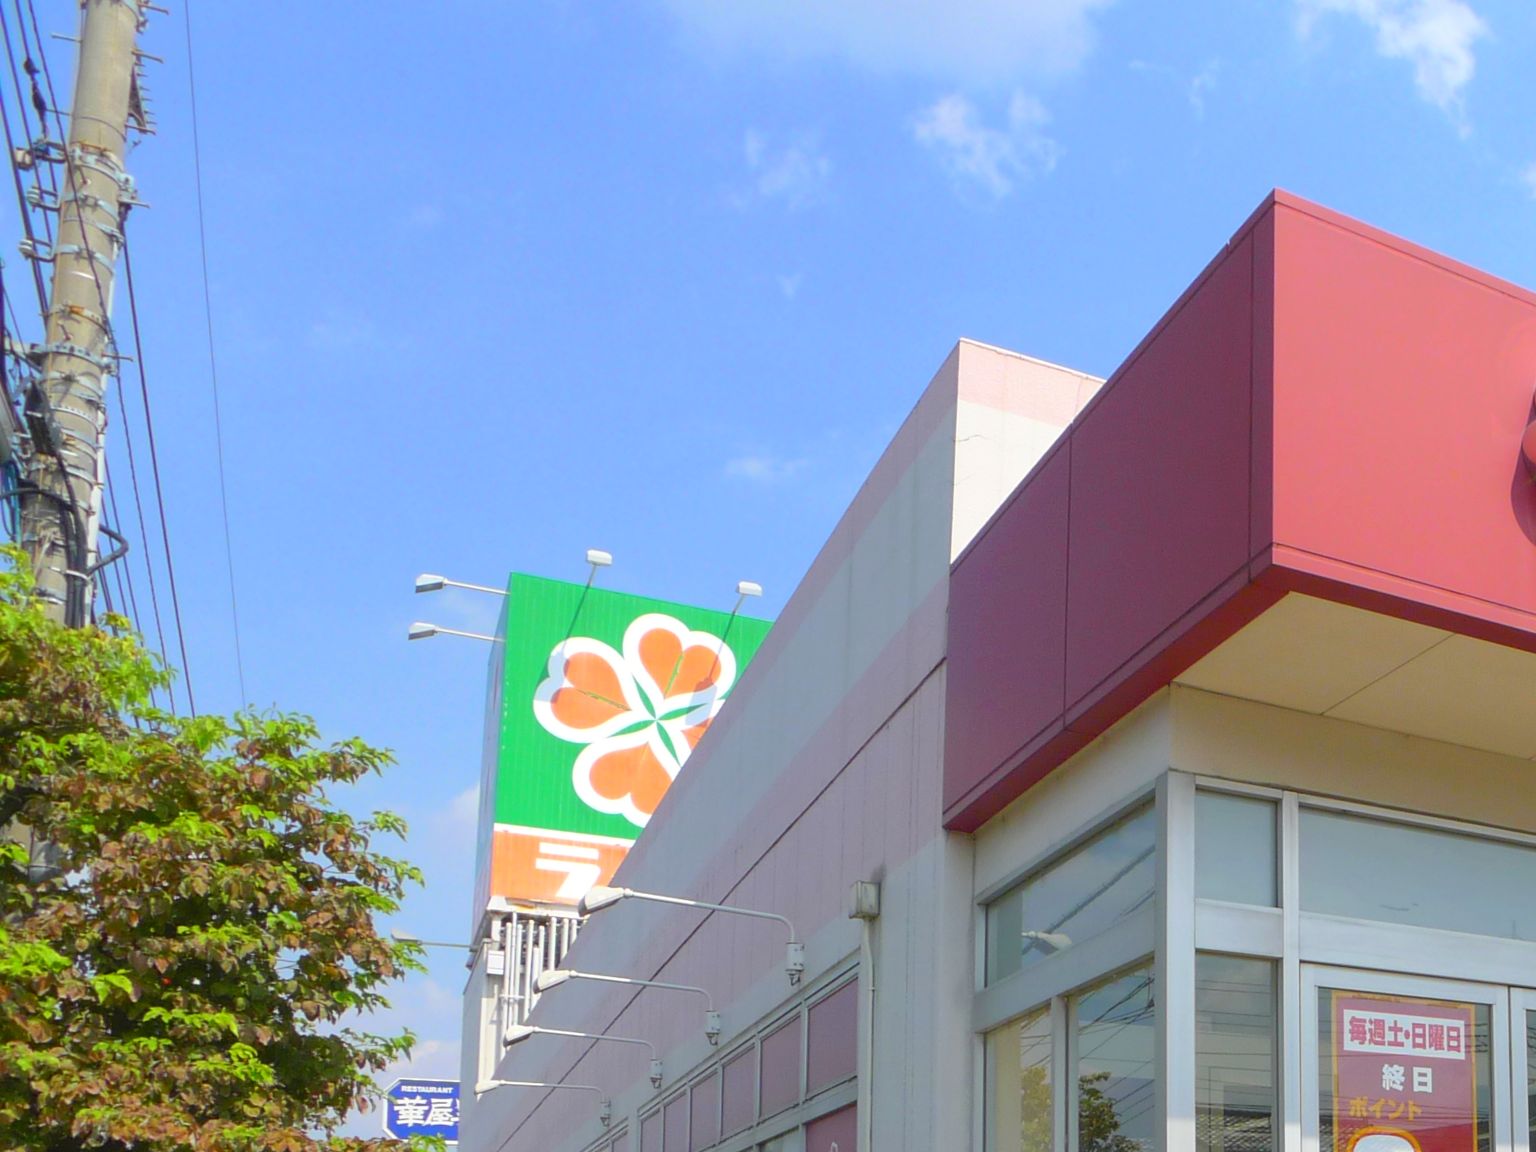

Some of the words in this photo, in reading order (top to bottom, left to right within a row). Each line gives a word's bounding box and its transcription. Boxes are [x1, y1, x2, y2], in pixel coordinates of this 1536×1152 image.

[535, 842, 602, 899] ラ
[1349, 1016, 1461, 1053] 毎週土・日曜日
[401, 1085, 454, 1094] RESTAURANT
[1382, 1063, 1432, 1093] 終日
[1349, 1096, 1422, 1120] ポイント
